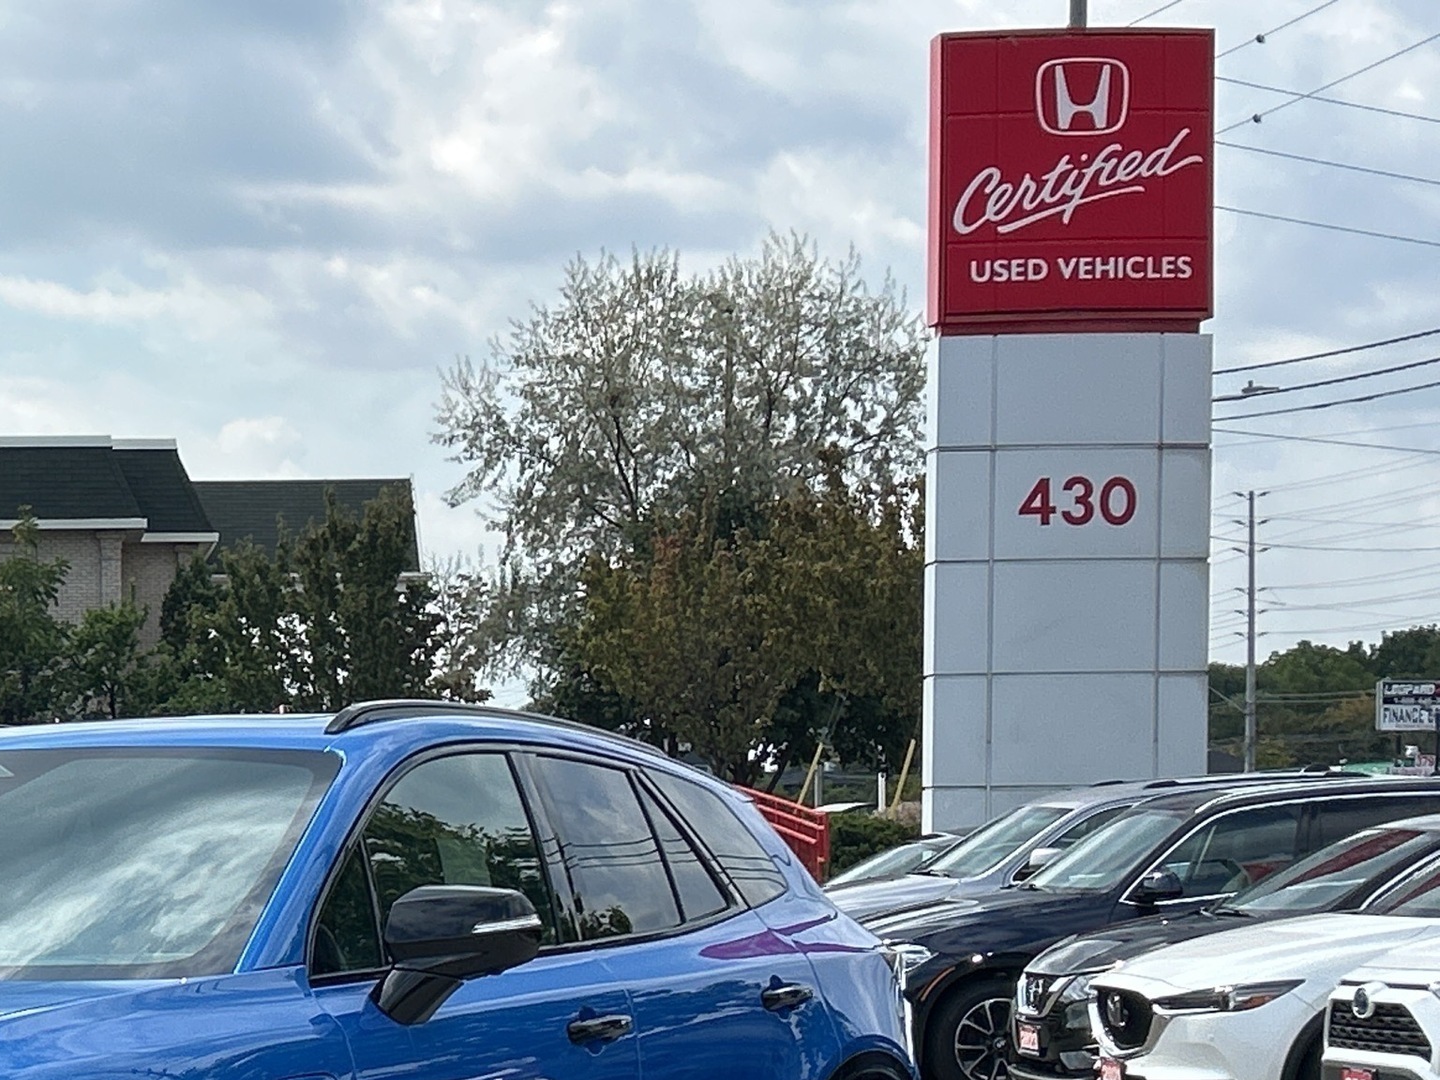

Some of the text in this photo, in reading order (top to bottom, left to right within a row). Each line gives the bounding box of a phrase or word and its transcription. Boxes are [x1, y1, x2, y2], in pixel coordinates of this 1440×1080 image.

[953, 127, 1203, 235] Certified
[970, 256, 1193, 283] USED VEHICLES
[1018, 476, 1137, 526] 430
